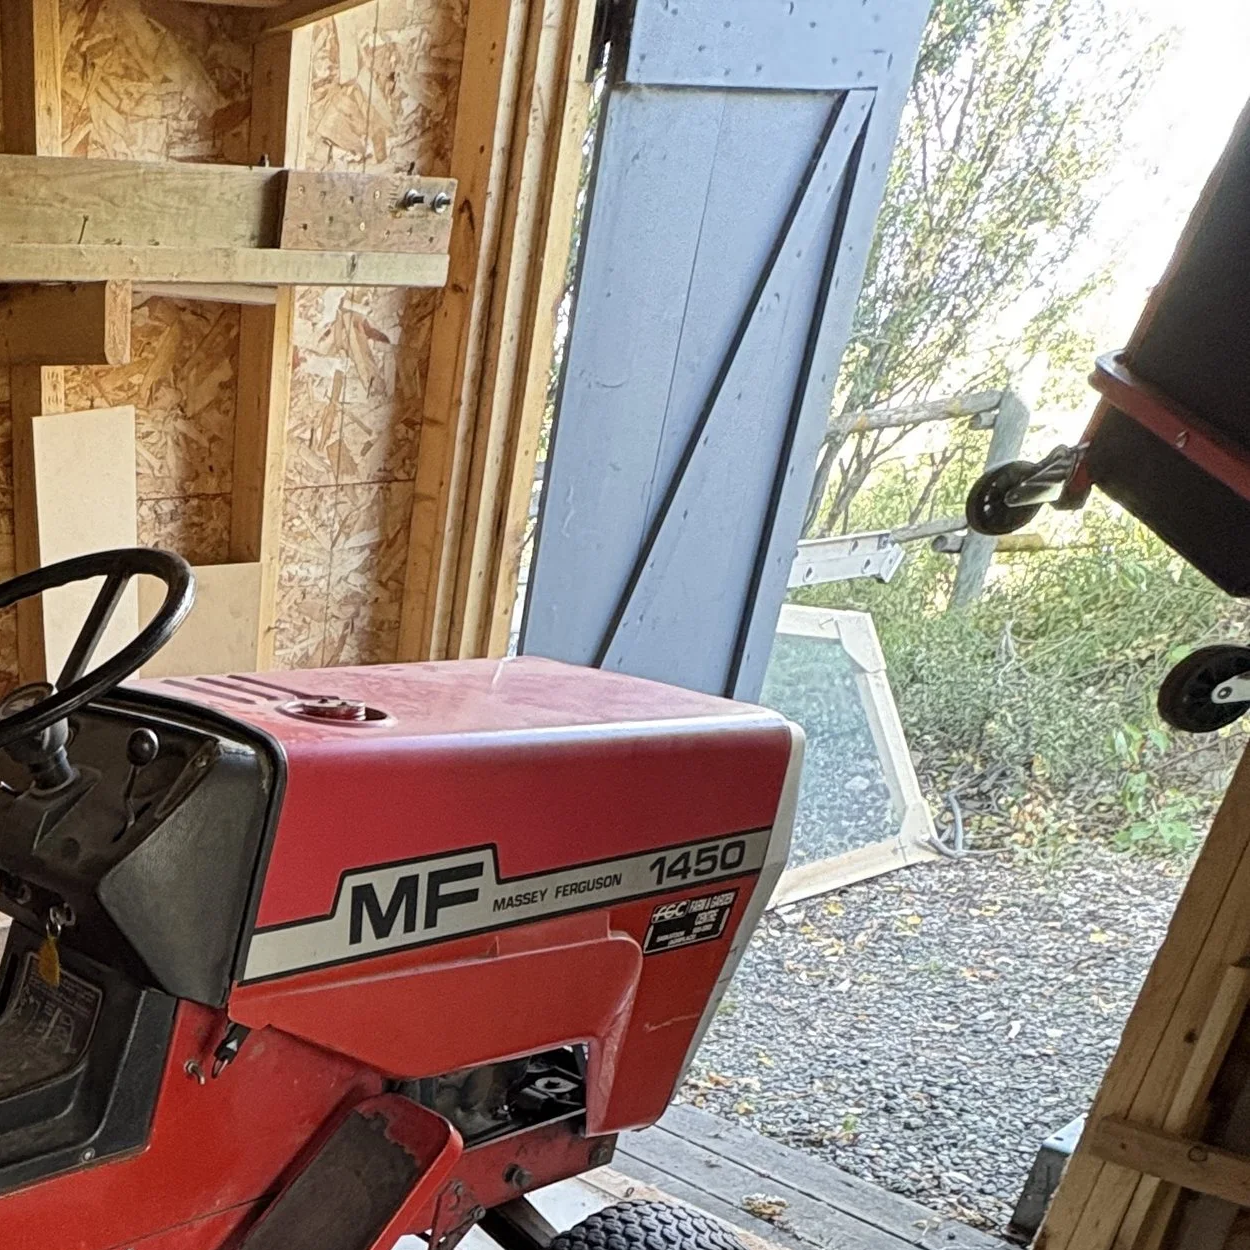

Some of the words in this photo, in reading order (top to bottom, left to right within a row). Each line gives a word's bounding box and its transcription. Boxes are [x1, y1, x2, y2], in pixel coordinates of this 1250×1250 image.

[649, 840, 746, 885] 1450
[349, 862, 484, 945] MF
[493, 888, 548, 912] MASSEY
[555, 873, 622, 898] FERGUSON
